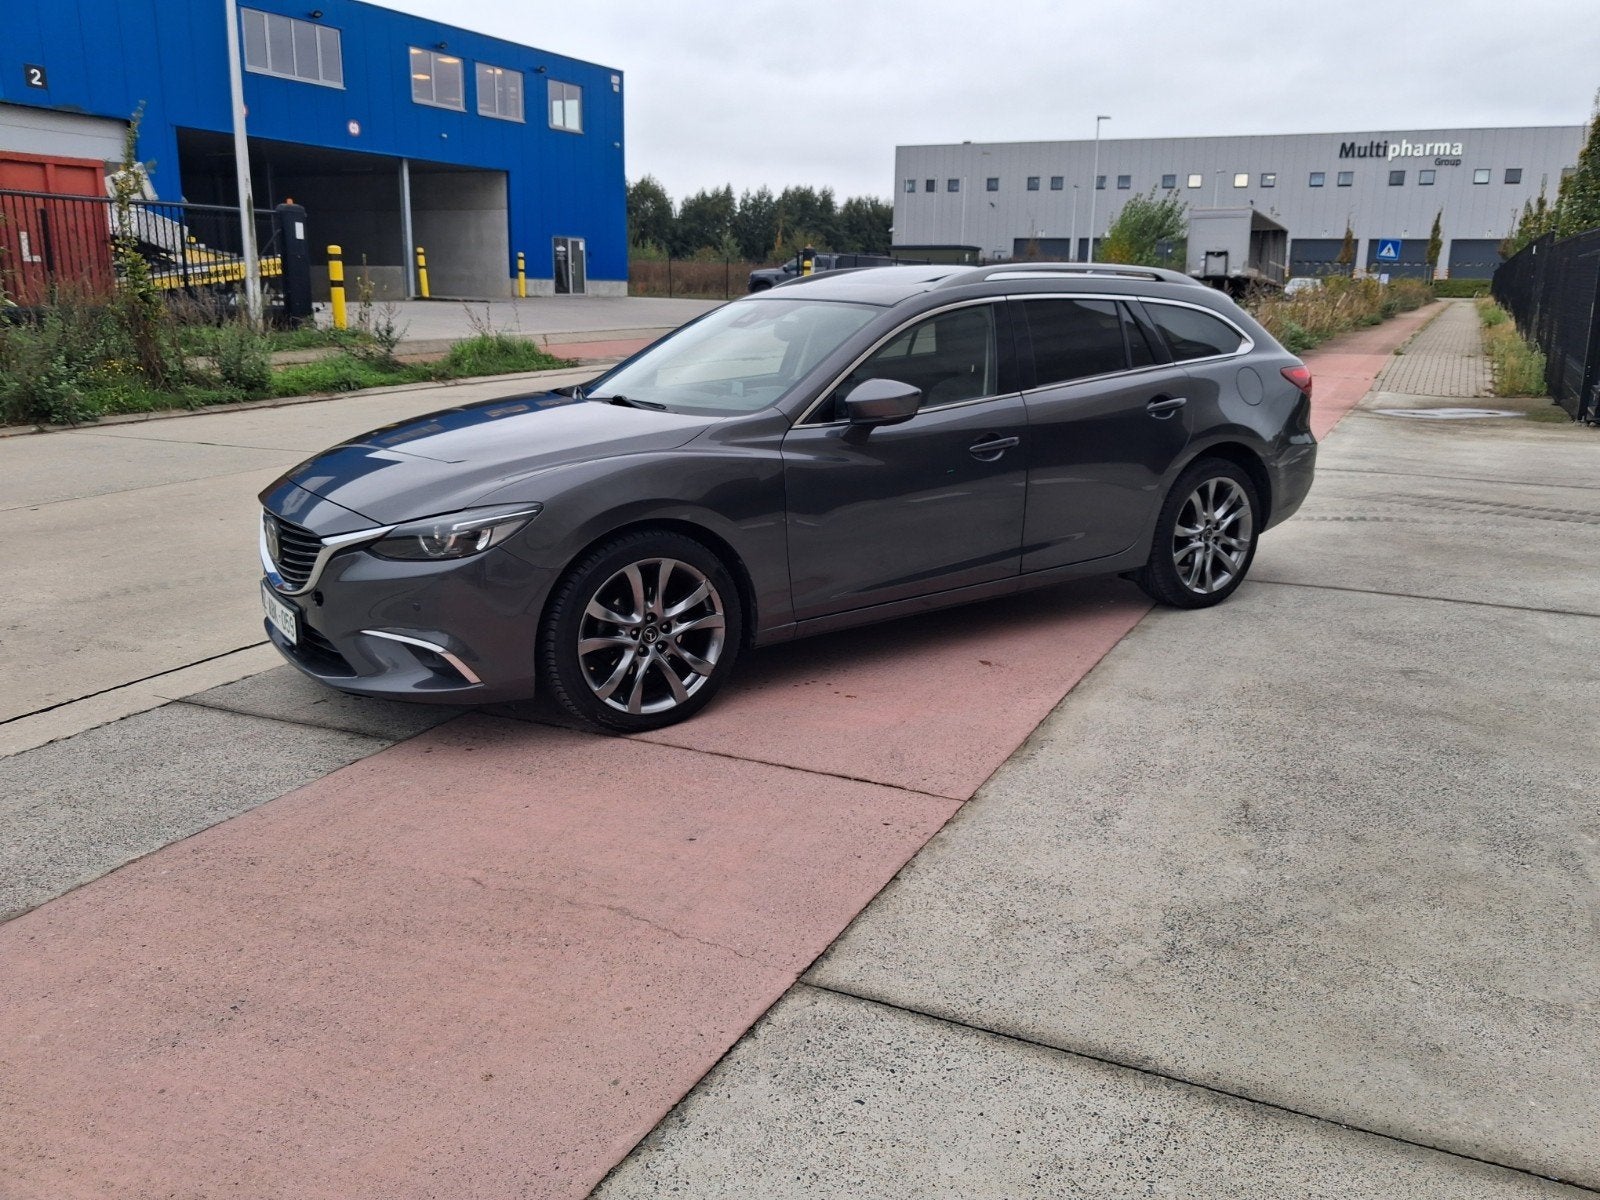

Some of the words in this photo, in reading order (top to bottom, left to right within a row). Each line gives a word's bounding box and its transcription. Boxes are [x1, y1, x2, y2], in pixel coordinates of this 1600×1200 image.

[30, 68, 43, 86] 2
[1338, 139, 1463, 162] Multipharma
[1434, 157, 1461, 167] Group
